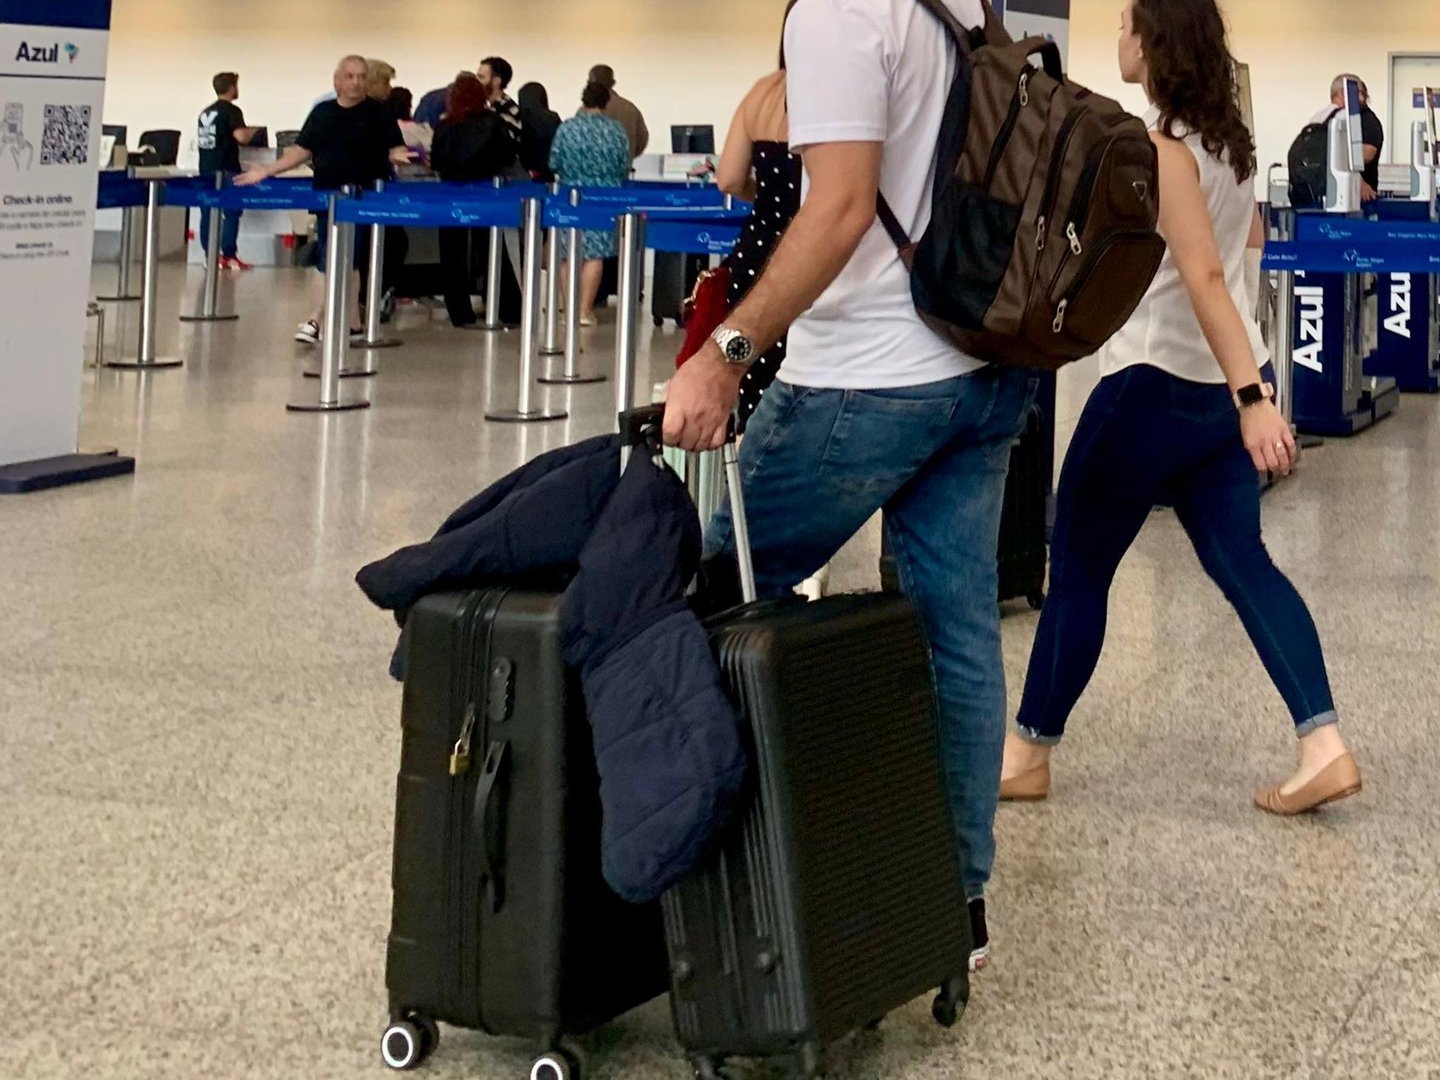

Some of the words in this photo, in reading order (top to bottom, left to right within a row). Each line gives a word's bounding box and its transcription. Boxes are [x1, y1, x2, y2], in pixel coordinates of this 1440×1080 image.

[16, 41, 58, 63] Azul
[2, 194, 44, 206] Check-in
[46, 194, 72, 204] online
[1384, 272, 1411, 338] Azu
[1292, 286, 1324, 374] Azul
